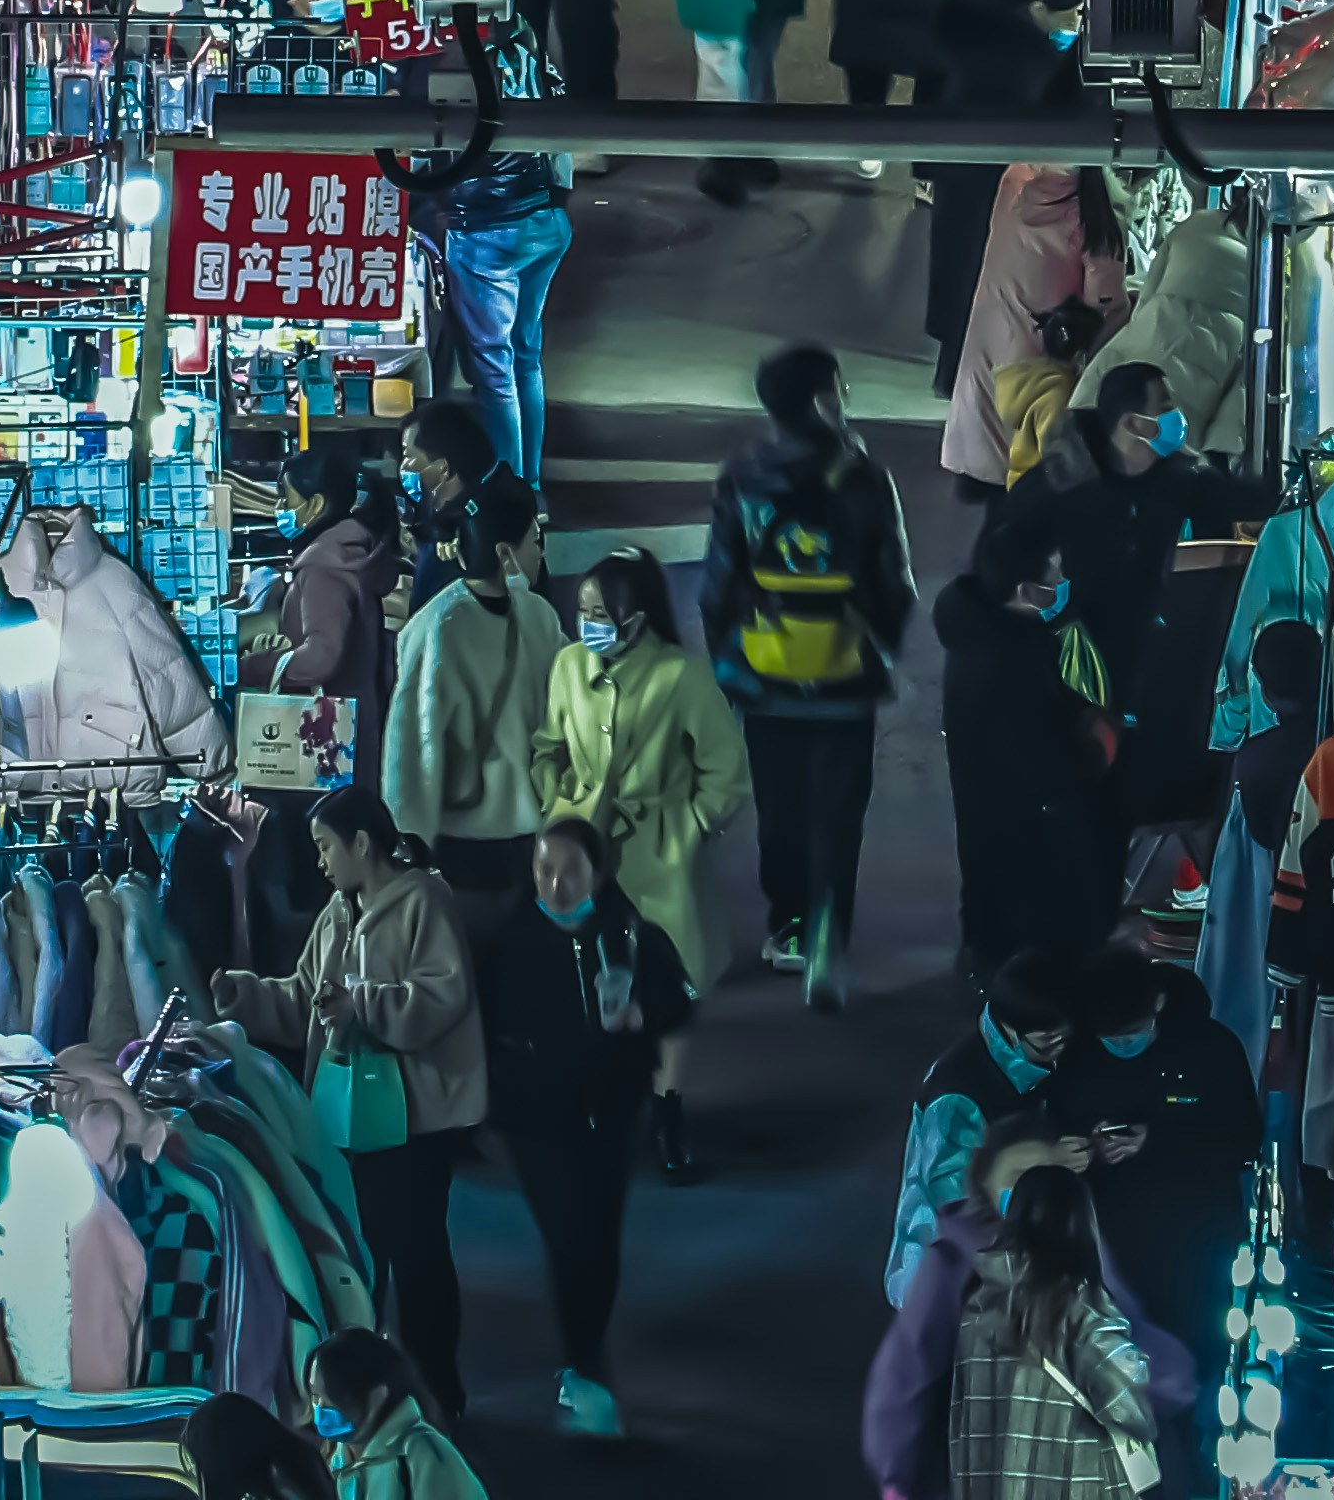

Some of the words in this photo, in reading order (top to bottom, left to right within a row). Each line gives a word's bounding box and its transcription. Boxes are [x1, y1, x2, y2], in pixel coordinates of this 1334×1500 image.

[198, 170, 401, 238] 专业贴膜
[194, 242, 397, 309] 国产手机壳
